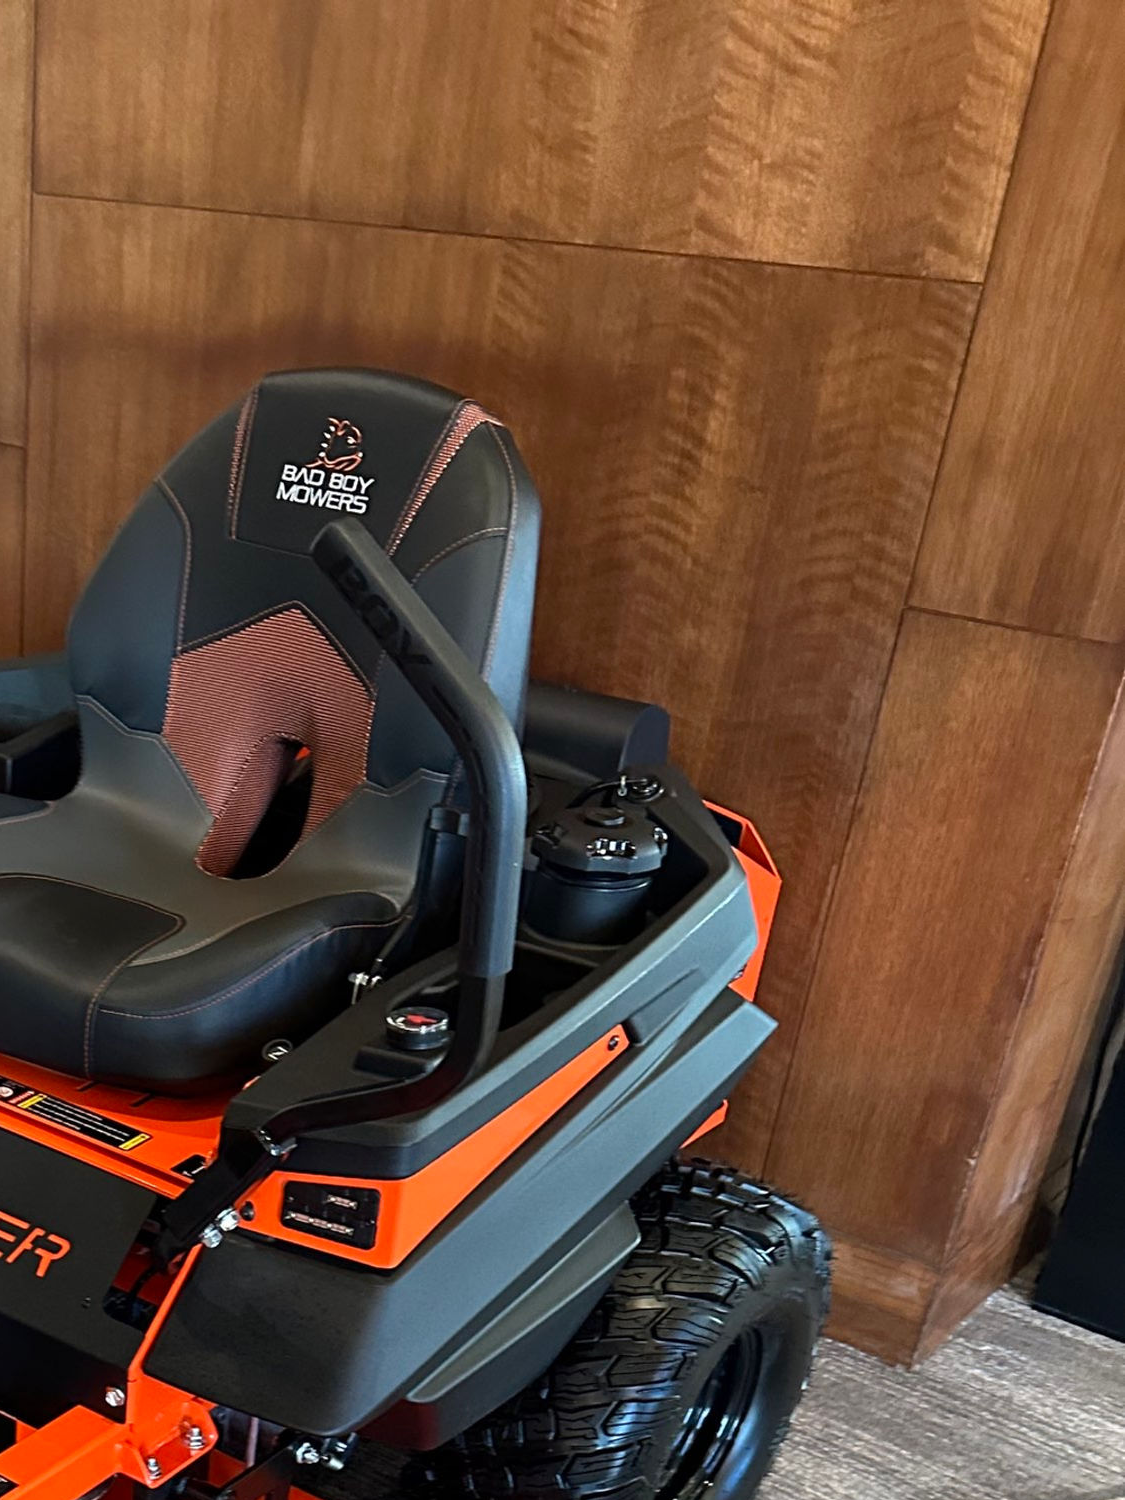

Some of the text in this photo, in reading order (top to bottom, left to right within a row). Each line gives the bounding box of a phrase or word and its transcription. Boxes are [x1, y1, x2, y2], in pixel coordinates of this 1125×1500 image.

[281, 464, 375, 494] BAD BOY
[276, 481, 369, 514] MOWERS
